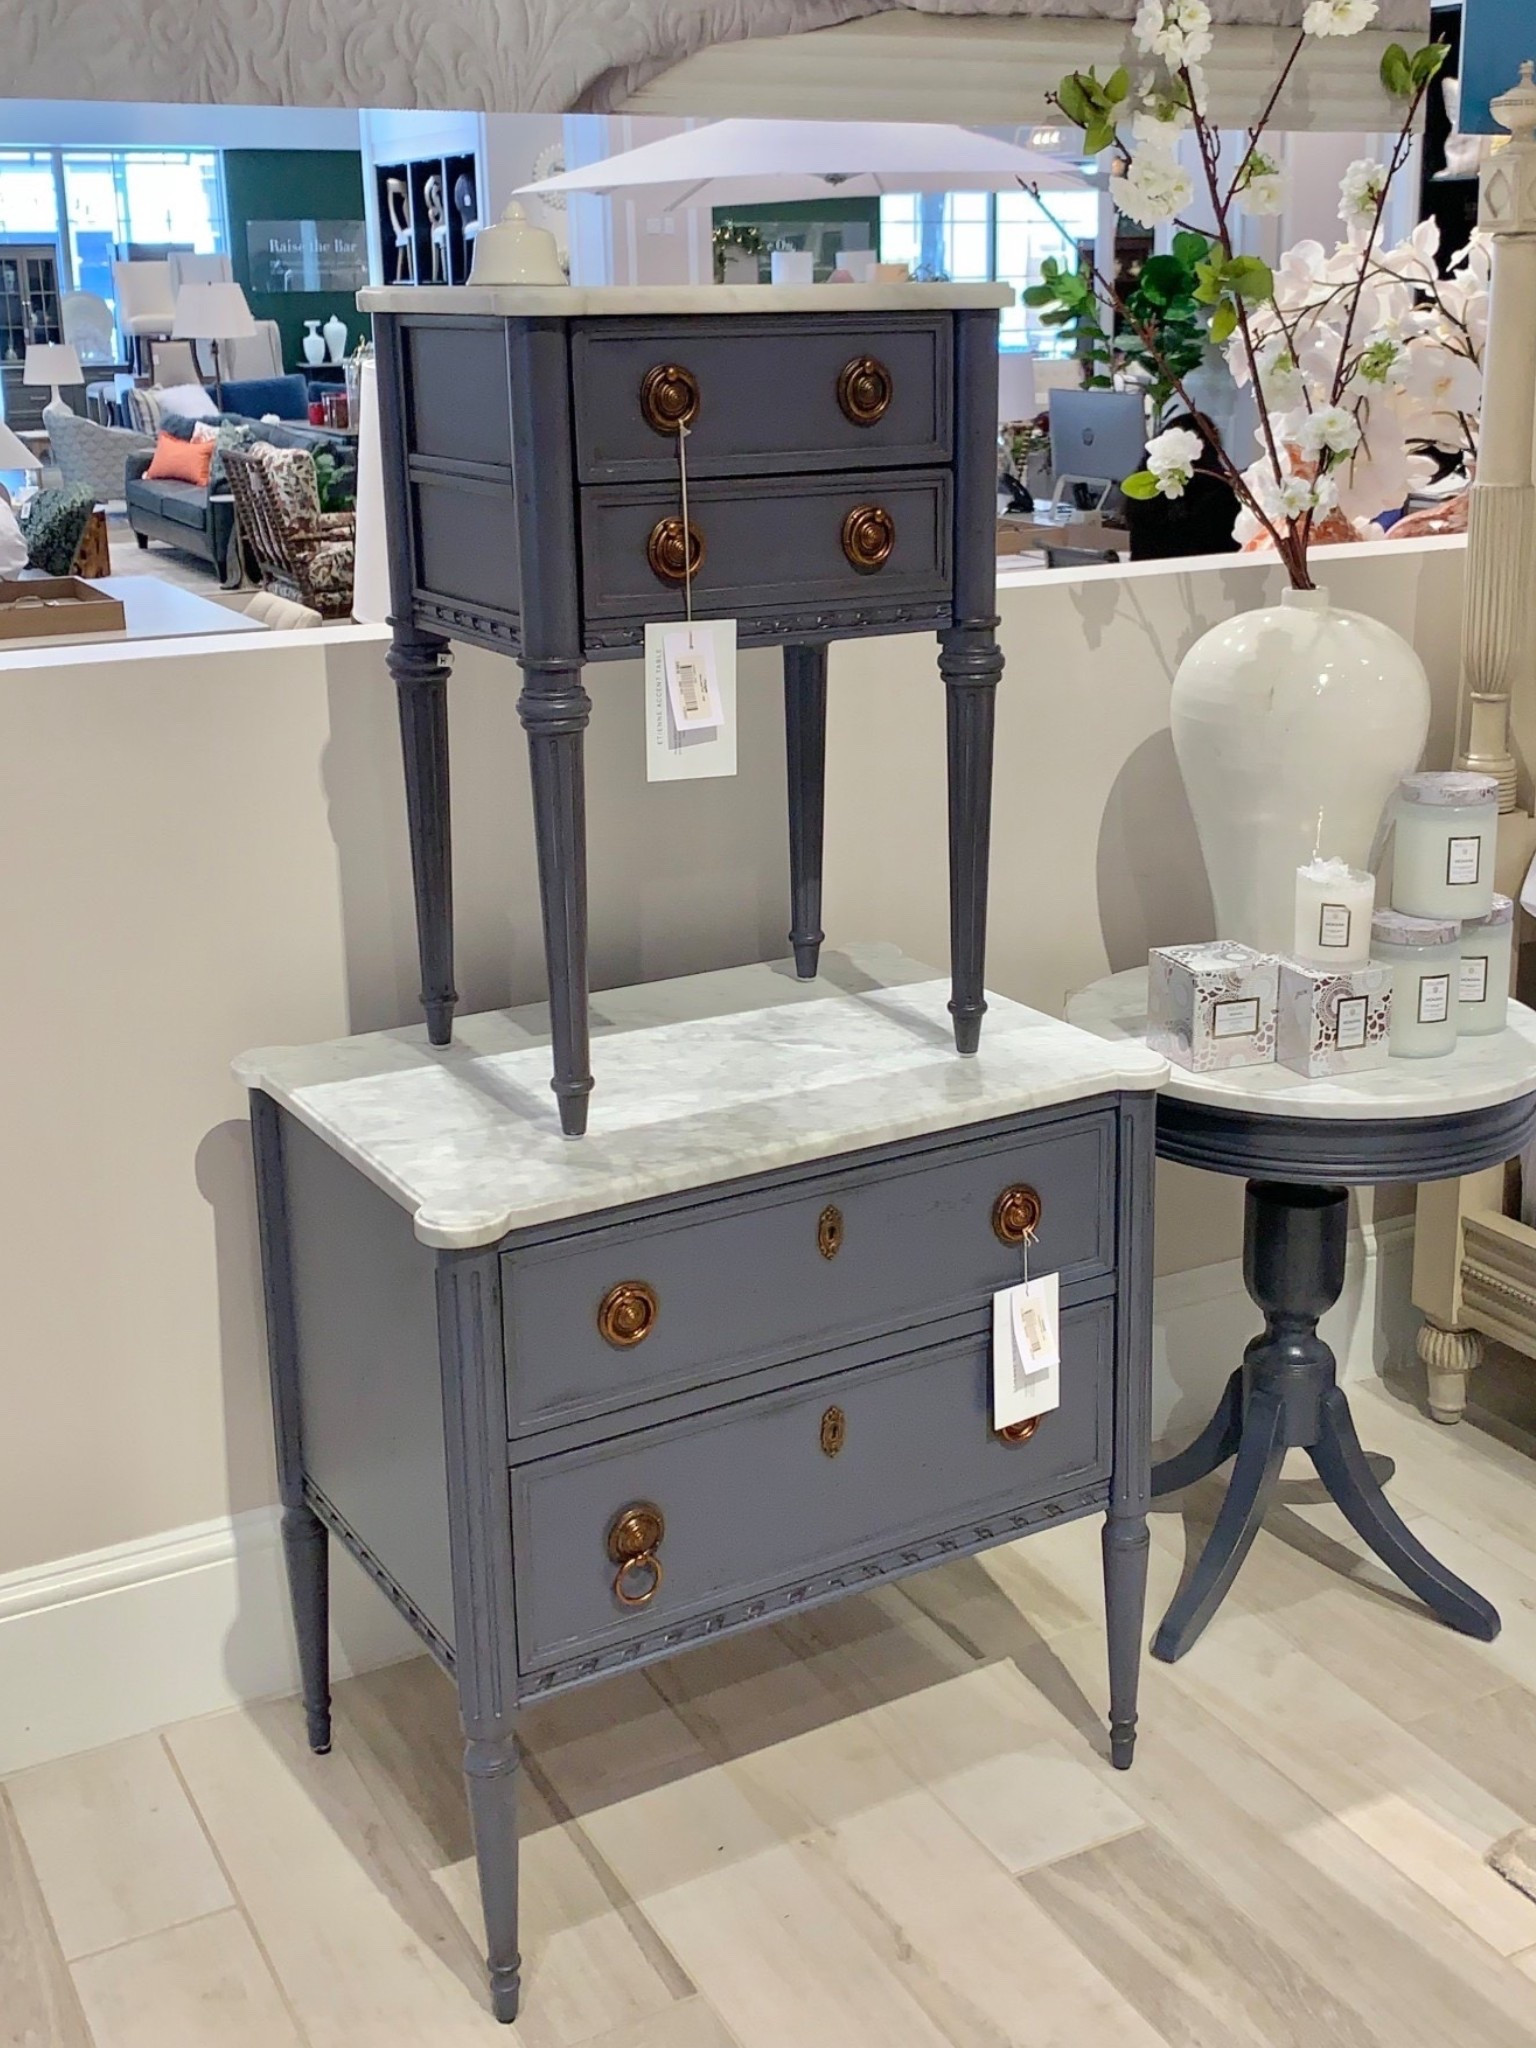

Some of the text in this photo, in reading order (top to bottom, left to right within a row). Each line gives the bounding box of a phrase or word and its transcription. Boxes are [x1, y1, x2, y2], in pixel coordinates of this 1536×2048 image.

[269, 239, 357, 253] Raise the Bar
[656, 711, 664, 745] ETIENNE
